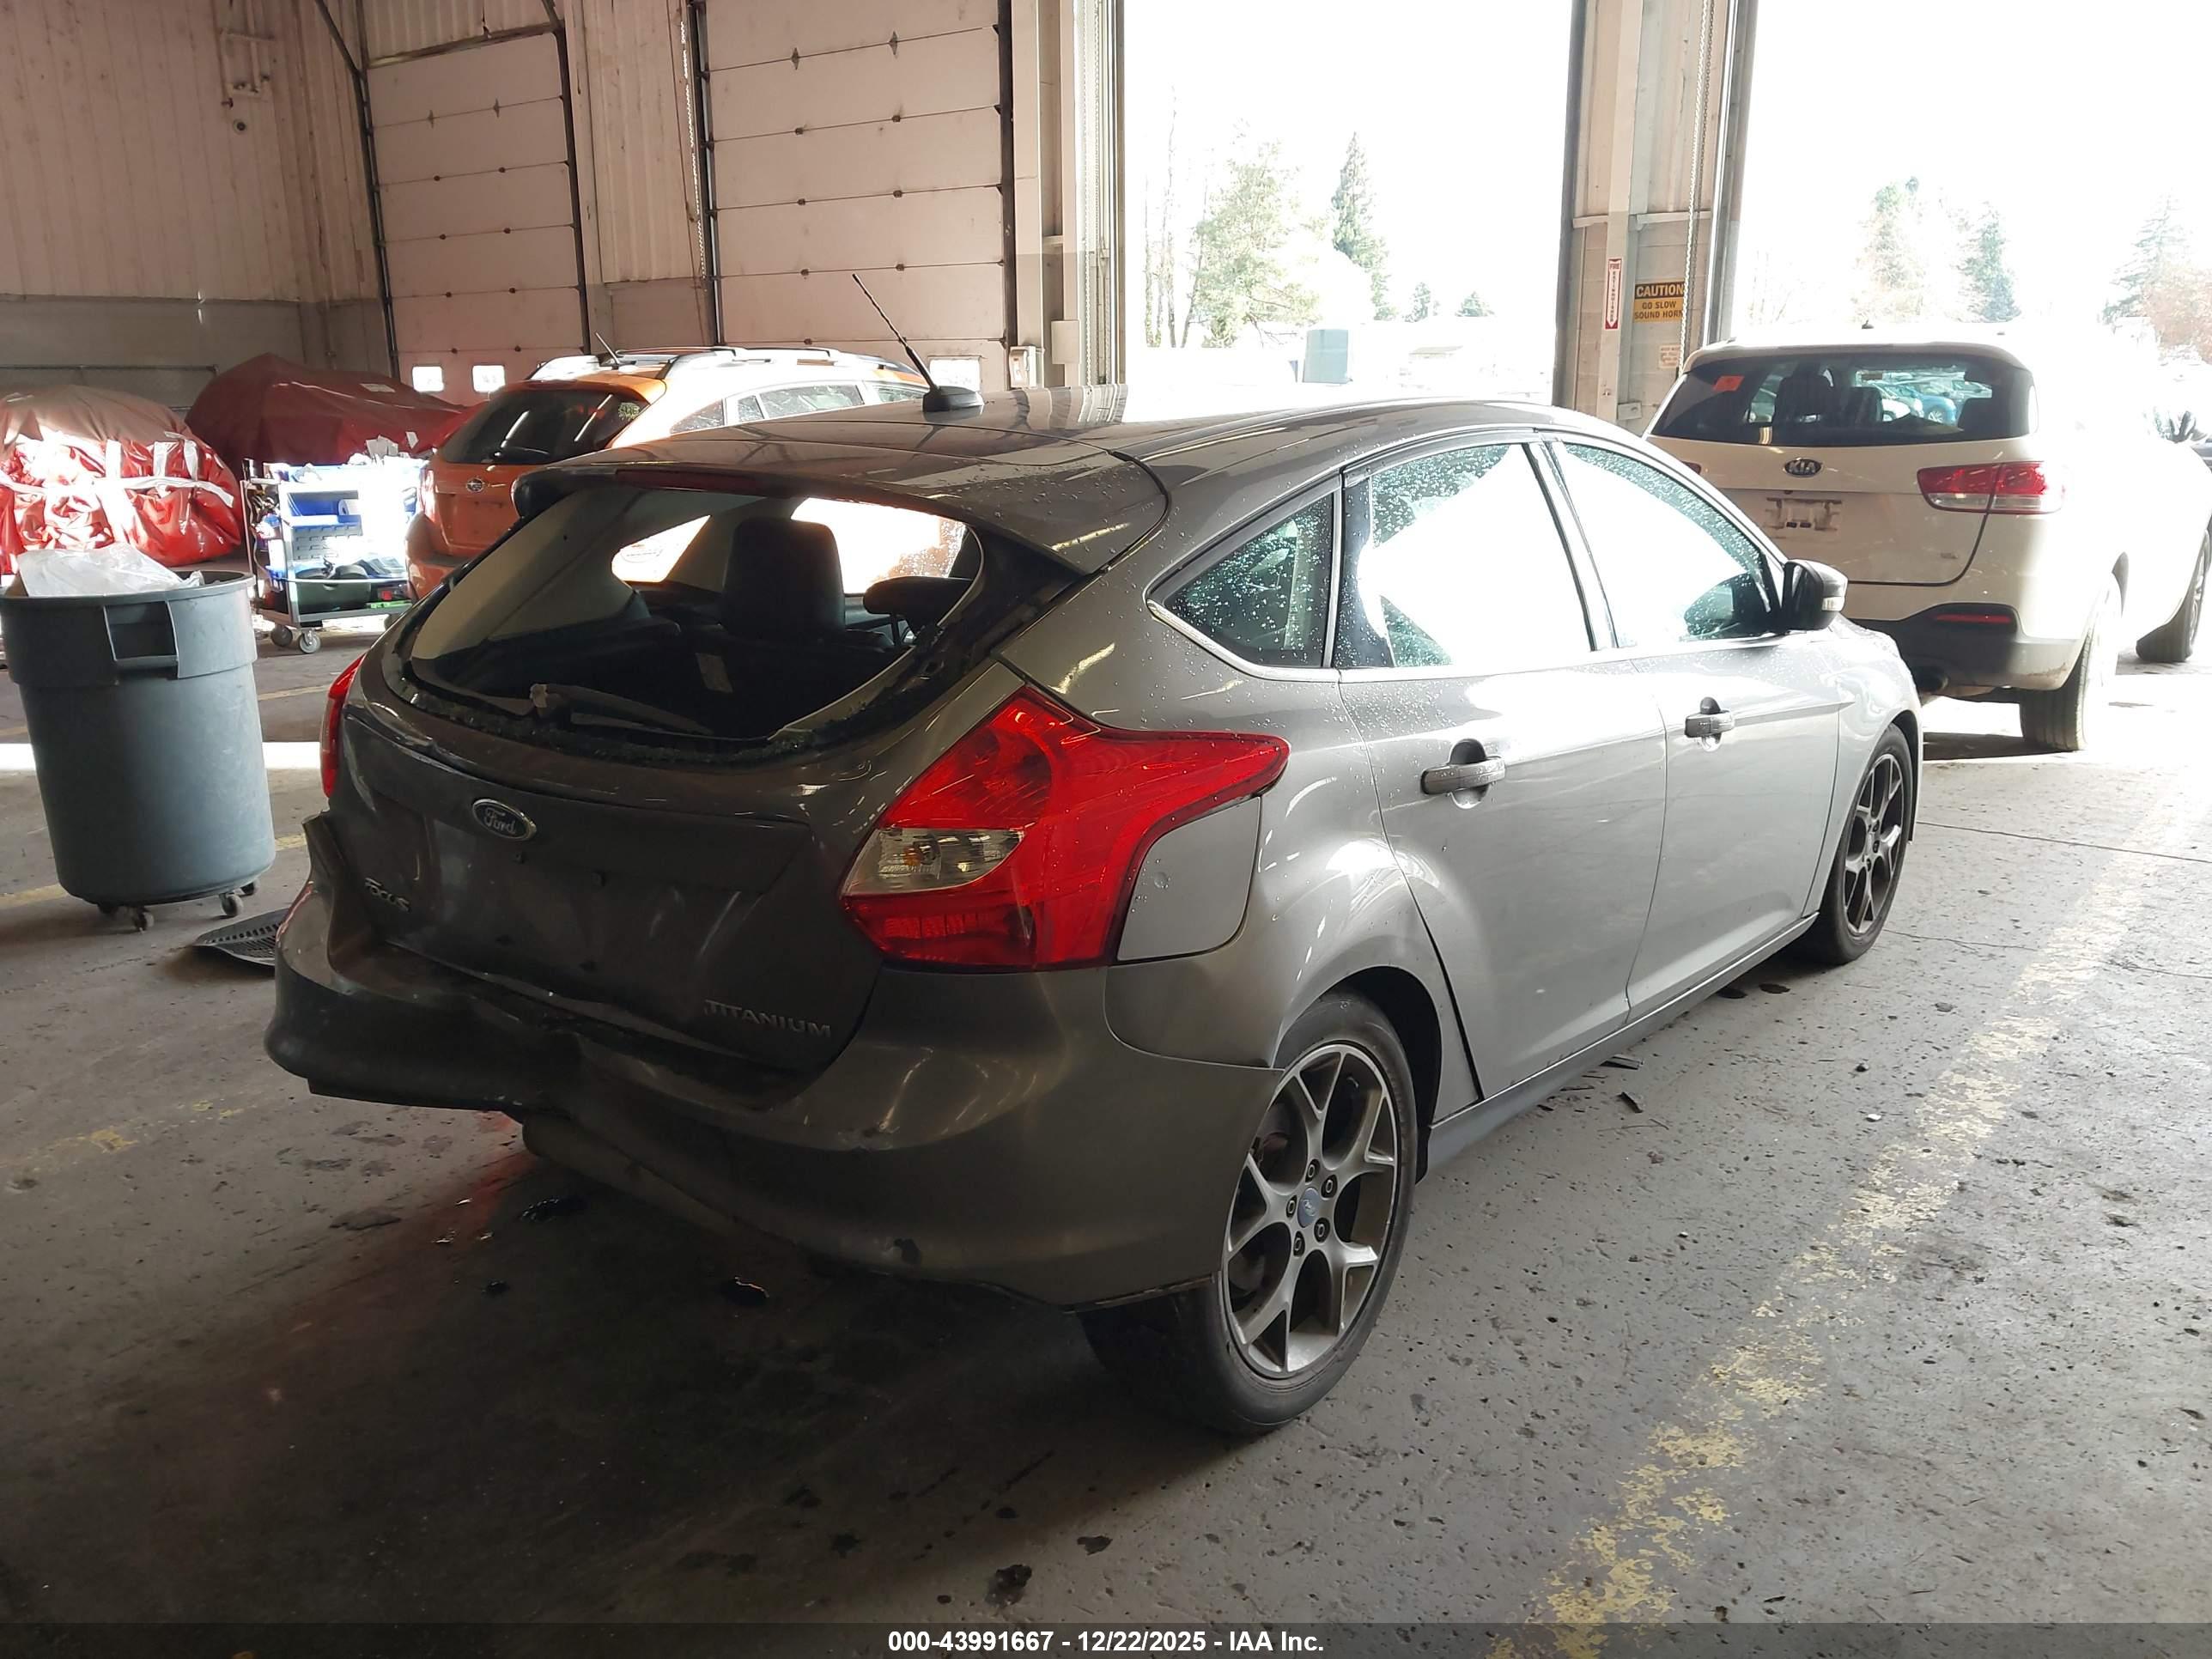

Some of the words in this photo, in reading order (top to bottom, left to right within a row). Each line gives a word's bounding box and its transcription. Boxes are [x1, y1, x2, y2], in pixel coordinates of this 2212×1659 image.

[1636, 283, 1684, 297] CAUTION
[1655, 301, 1676, 309] SLOW
[1635, 311, 1661, 319] SOUND
[703, 999, 832, 1037] TITANIUM
